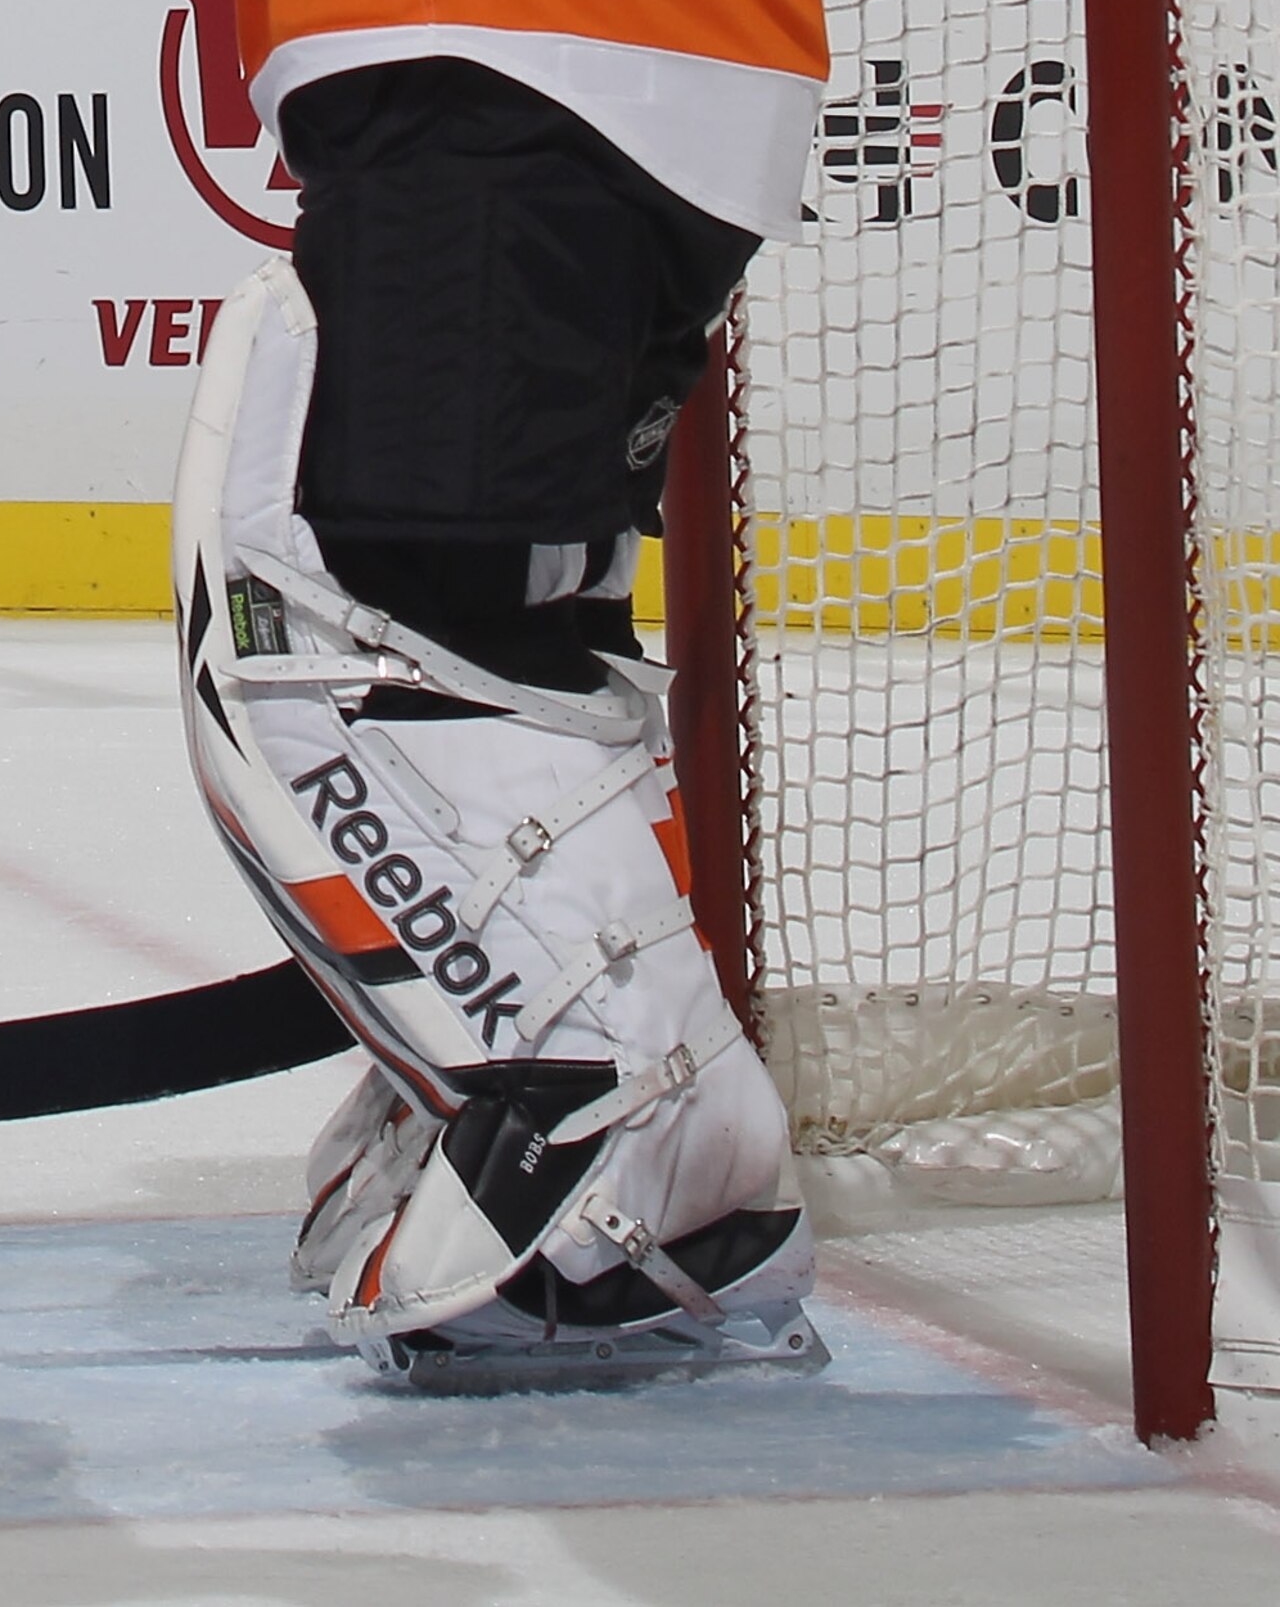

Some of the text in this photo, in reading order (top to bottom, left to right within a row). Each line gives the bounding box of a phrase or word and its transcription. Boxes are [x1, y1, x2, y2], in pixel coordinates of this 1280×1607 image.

[230, 593, 250, 649] Reebok
[289, 753, 524, 1049] Reebok
[519, 1132, 547, 1173] BOBS
